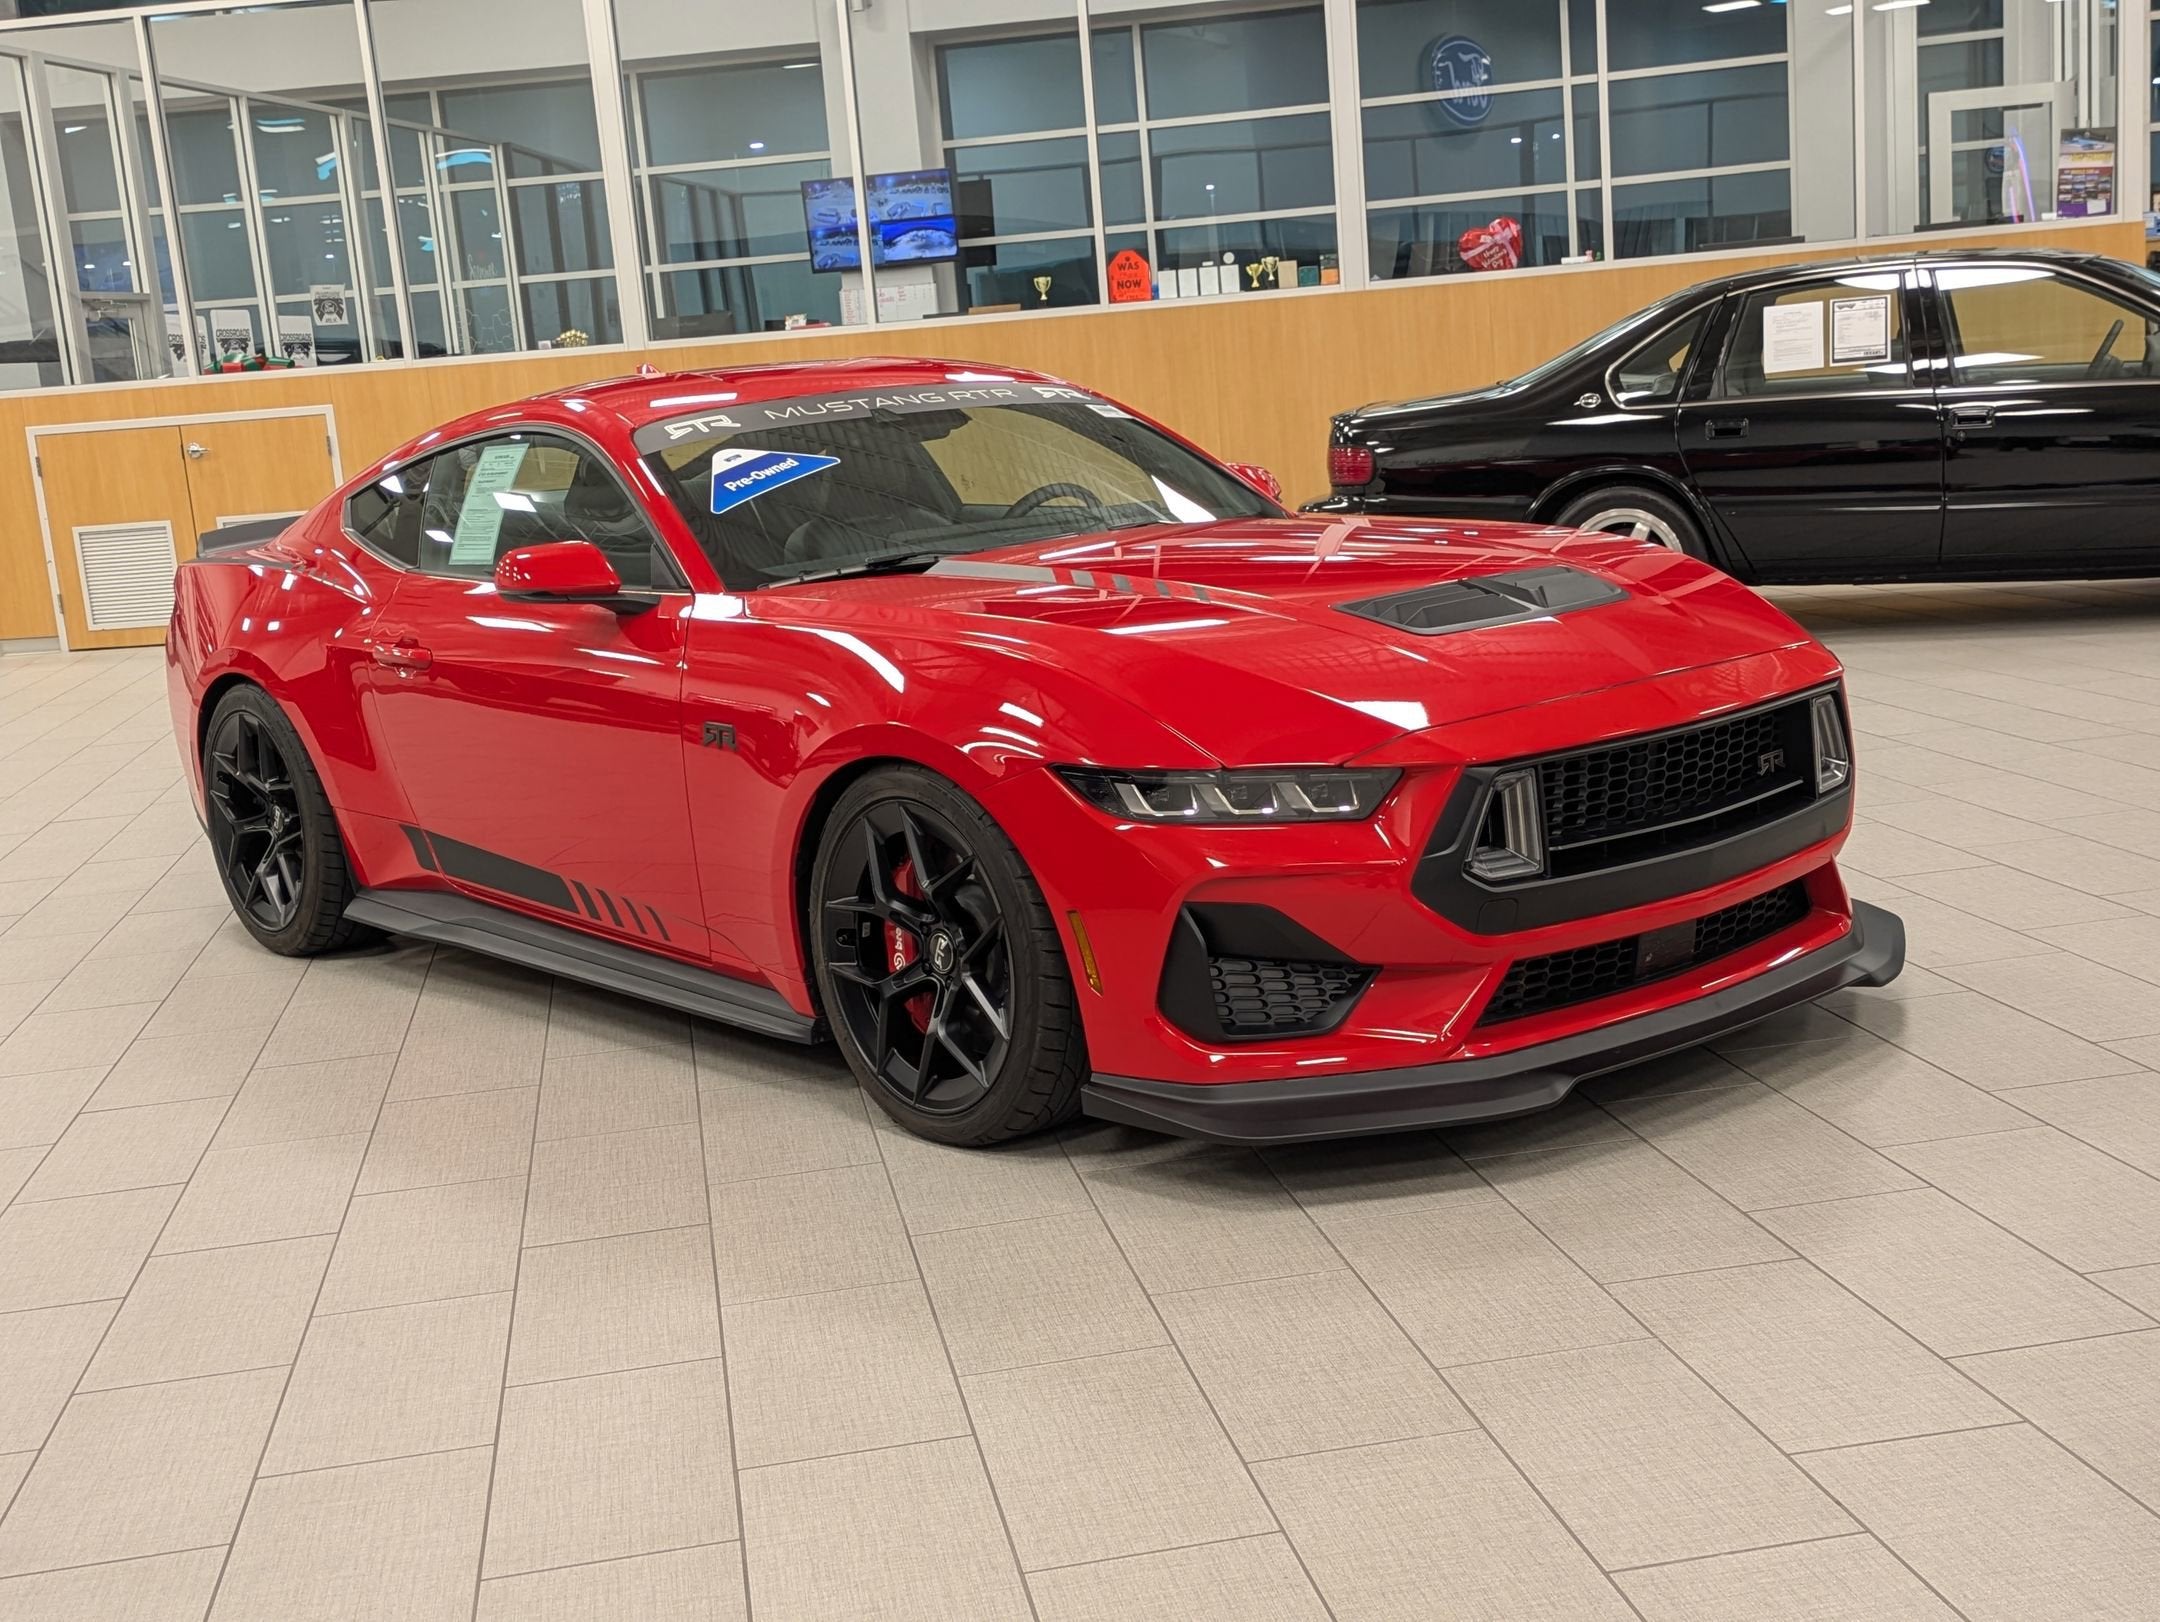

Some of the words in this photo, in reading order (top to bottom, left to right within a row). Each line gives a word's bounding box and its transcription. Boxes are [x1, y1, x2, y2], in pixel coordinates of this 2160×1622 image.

[1116, 261, 1140, 271] WAS
[1116, 279, 1142, 291] NOW
[216, 328, 250, 338] CROSSROADS
[280, 333, 312, 342] CROSSROADS
[764, 392, 946, 420] MUSTANG
[947, 388, 1018, 401] RTR
[723, 457, 800, 492] Pre-Owned
